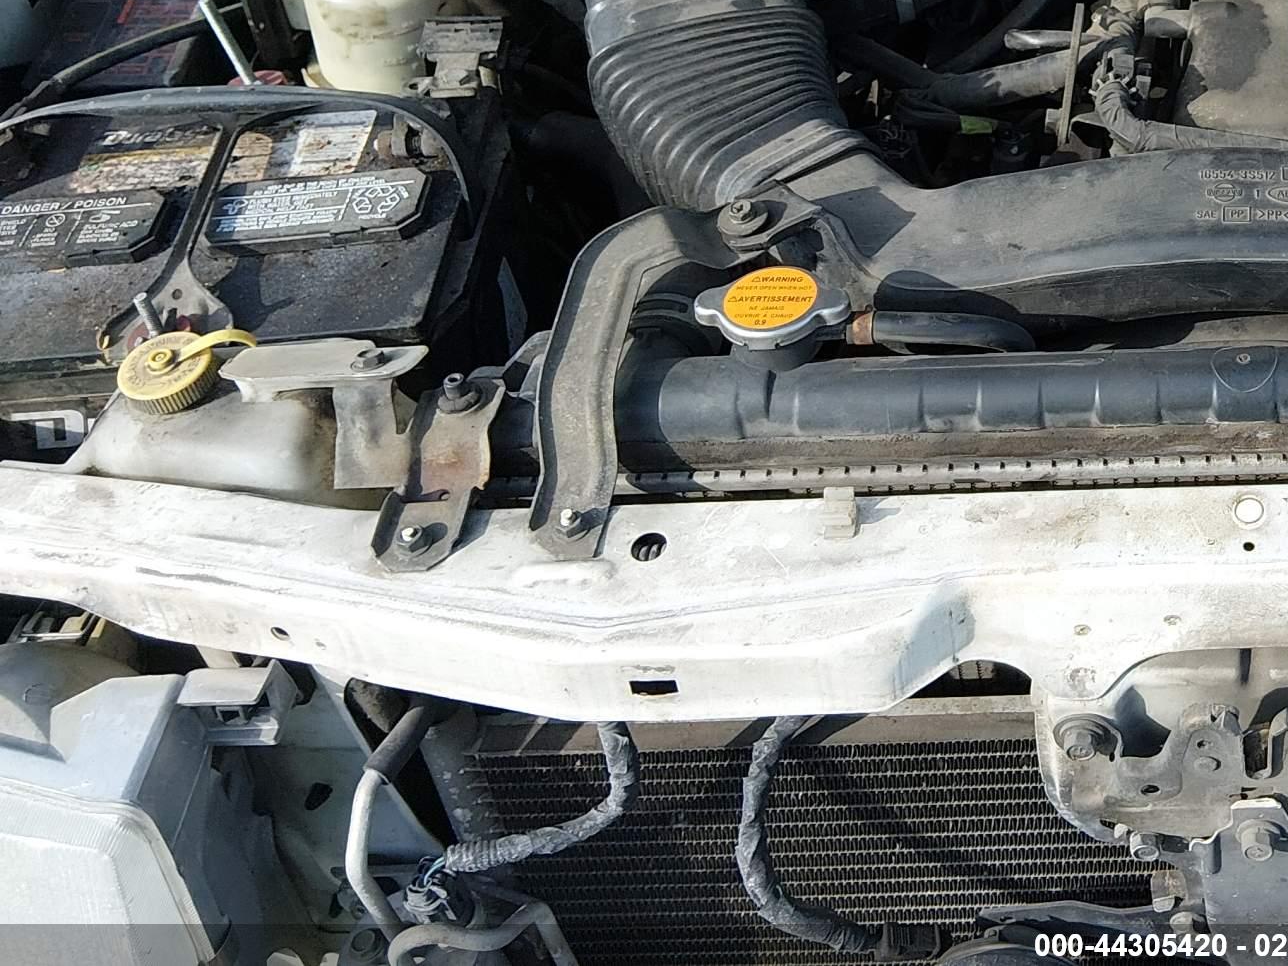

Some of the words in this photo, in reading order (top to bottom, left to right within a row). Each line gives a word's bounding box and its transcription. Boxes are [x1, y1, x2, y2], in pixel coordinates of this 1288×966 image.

[1, 202, 60, 215] DANGER
[73, 197, 127, 209] POISON
[1196, 209, 1217, 220] SAE
[1230, 208, 1245, 219] PP
[737, 295, 814, 303] AVERTISSEMENT
